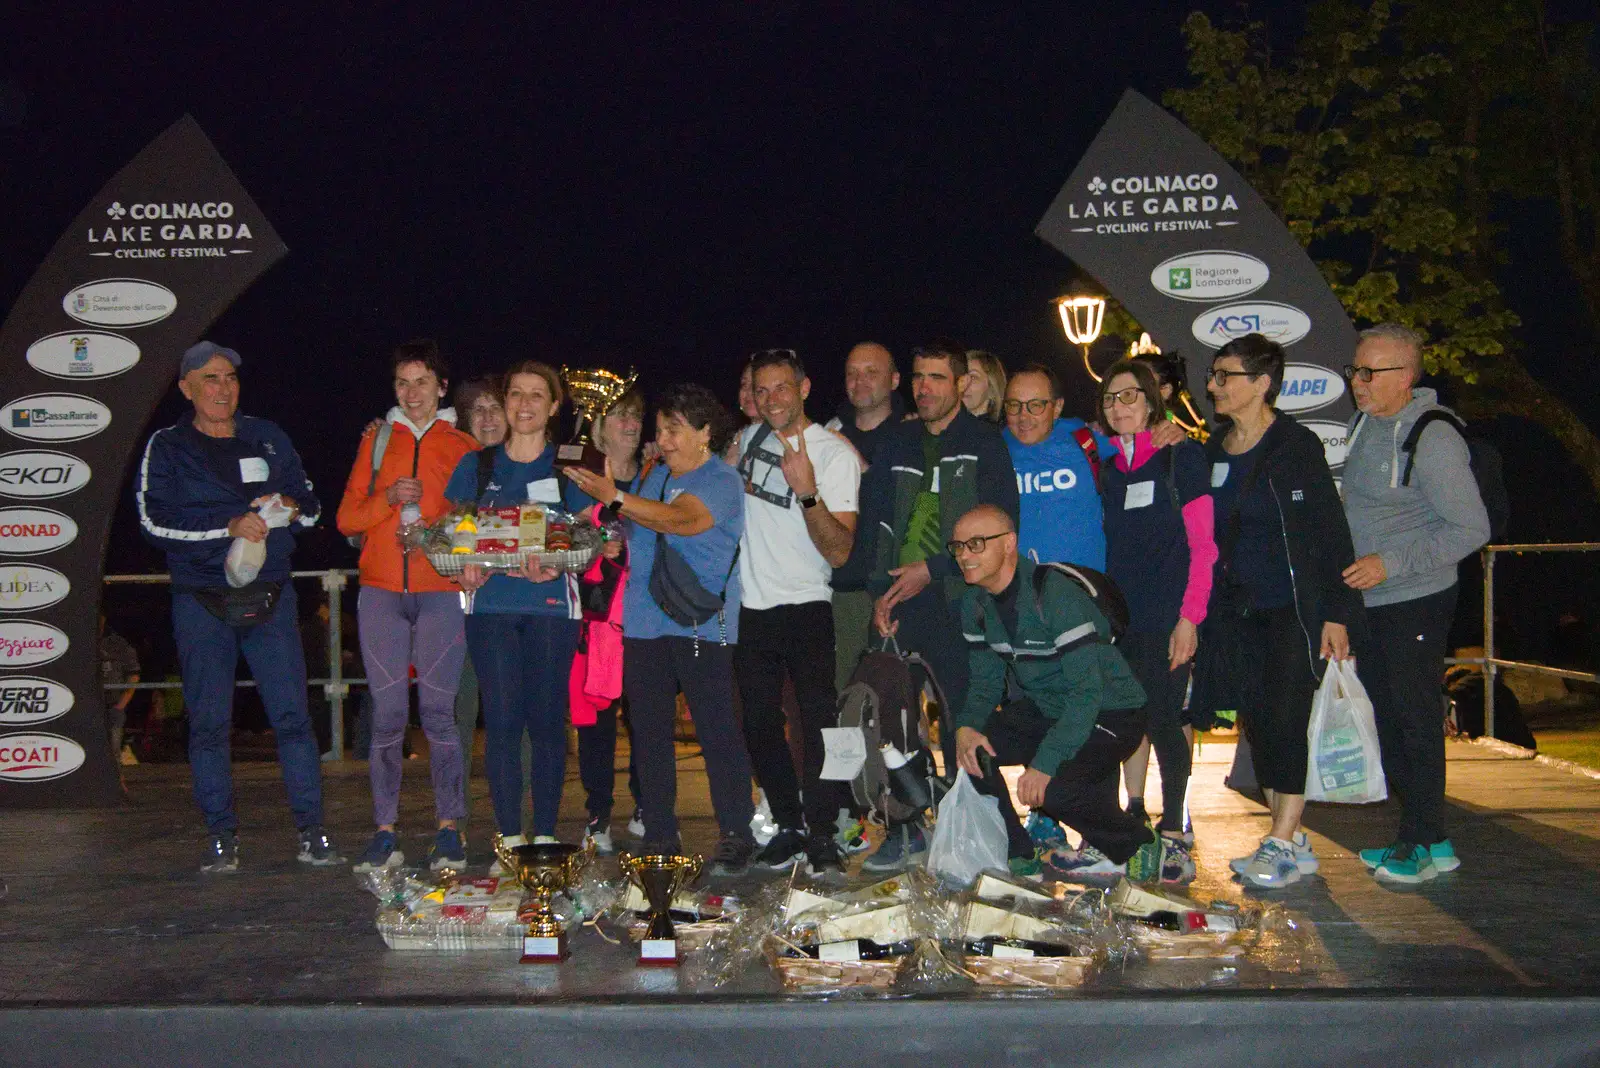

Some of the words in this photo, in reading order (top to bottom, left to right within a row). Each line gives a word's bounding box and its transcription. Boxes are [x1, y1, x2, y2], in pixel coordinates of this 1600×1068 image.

[1111, 173, 1218, 194] COLNAGO
[130, 202, 234, 220] COLNAGO
[1069, 200, 1134, 218] LAKE
[1143, 195, 1238, 214] GARDA
[88, 226, 152, 242] LAKE
[160, 223, 252, 240] GARDA
[1096, 222, 1149, 234] CYCLING
[1154, 220, 1212, 232] FESTIVAL
[114, 249, 166, 259] CYCLING
[171, 247, 227, 257] FESTIVAL
[1195, 267, 1239, 278] Regione
[1195, 277, 1252, 287] Lombardia
[1210, 314, 1260, 334] ACSI
[0, 524, 61, 537] CONAD
[0, 687, 49, 701] ERO
[0, 747, 58, 763] COATI
